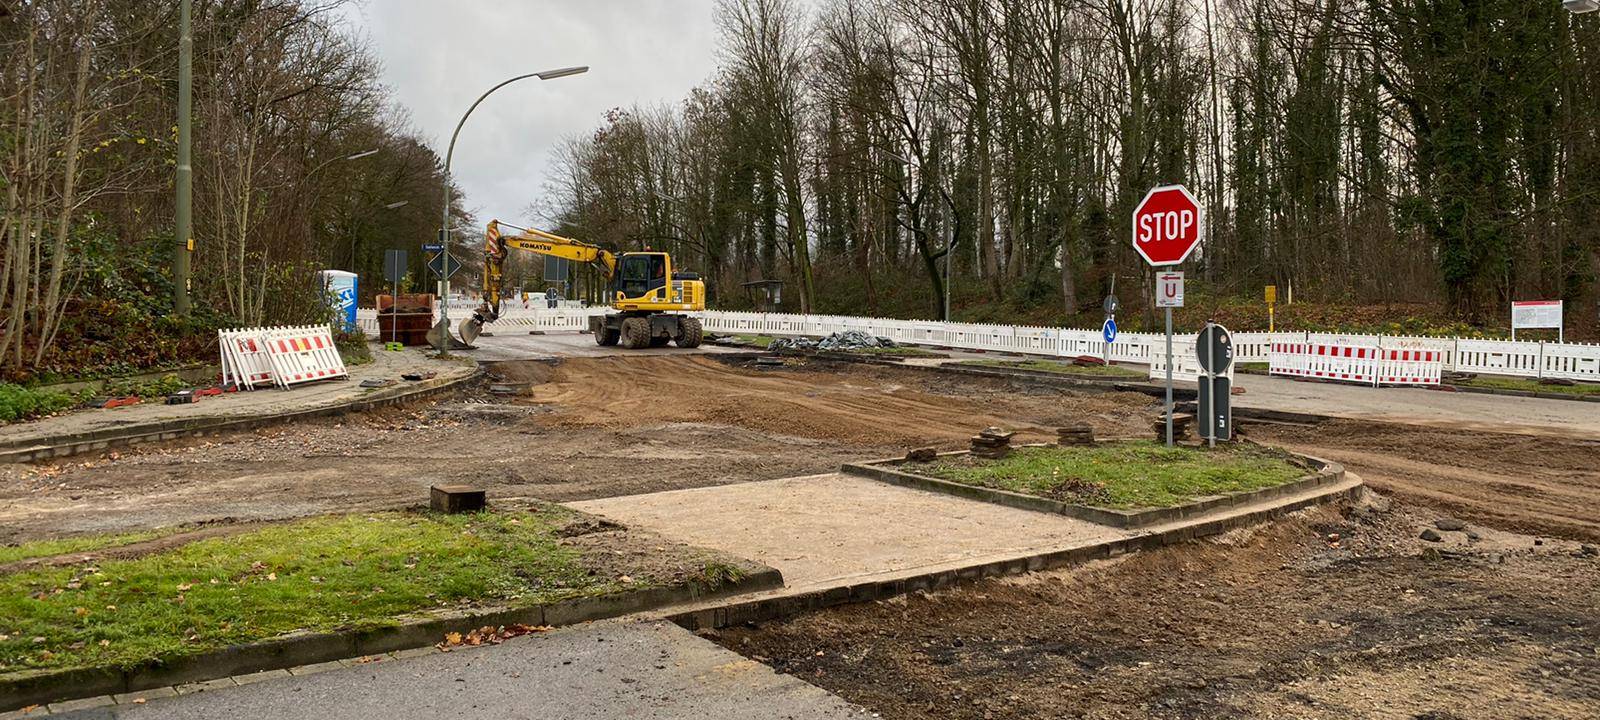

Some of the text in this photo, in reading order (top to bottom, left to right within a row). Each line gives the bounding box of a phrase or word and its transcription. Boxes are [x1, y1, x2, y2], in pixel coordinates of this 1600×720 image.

[1140, 209, 1193, 243] STOP
[519, 242, 552, 251] KOMATSU
[1165, 283, 1176, 298] U
